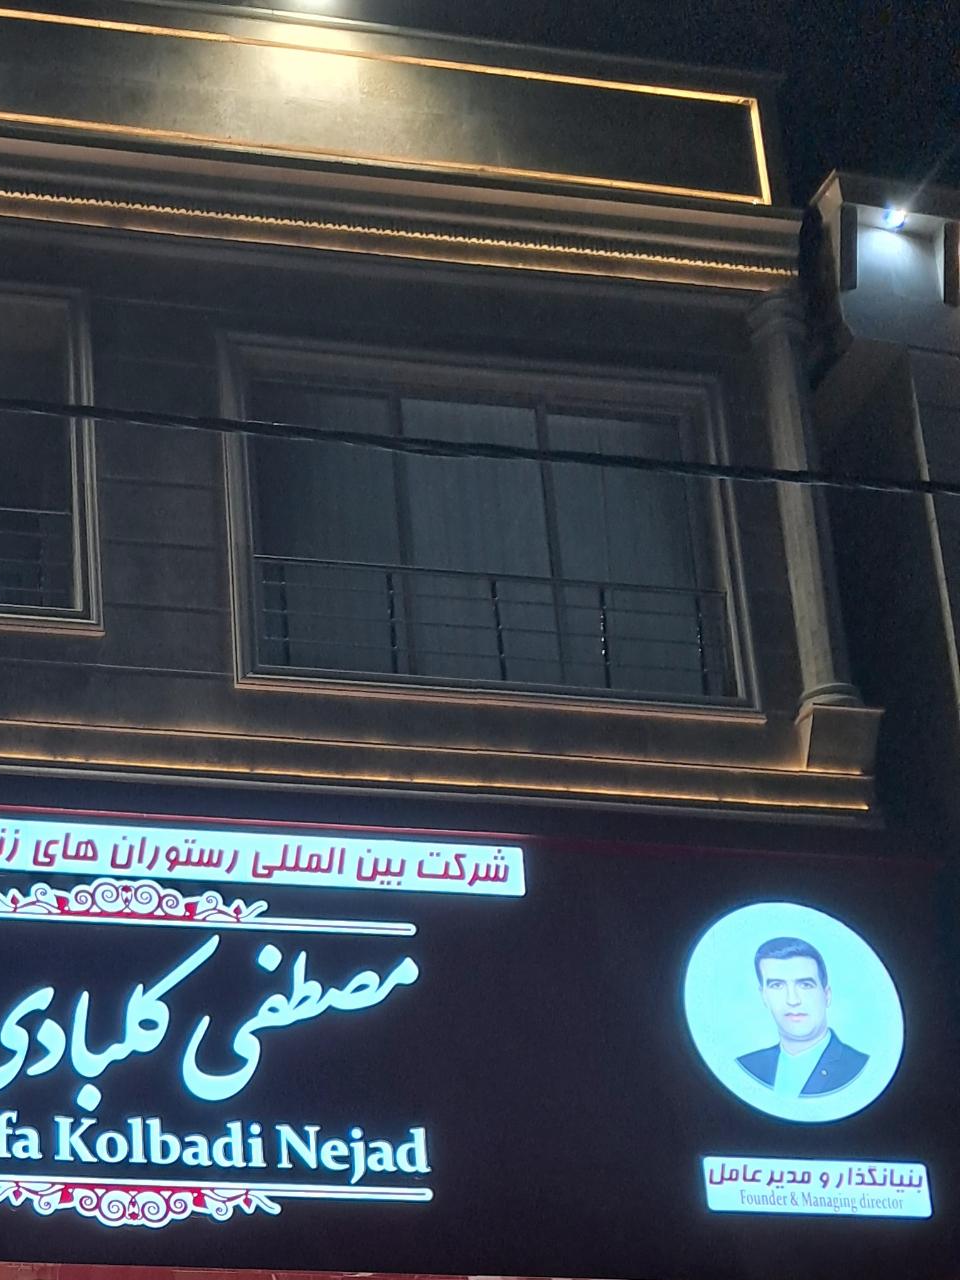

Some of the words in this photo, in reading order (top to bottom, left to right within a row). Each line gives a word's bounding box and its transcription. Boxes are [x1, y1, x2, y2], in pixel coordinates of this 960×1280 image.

[32, 831, 98, 868] های
[110, 836, 239, 875] رستوران
[251, 843, 347, 879] المللی
[356, 849, 407, 886] بین
[417, 847, 510, 887] شرکت
[180, 943, 421, 1102] مصطفی
[54, 1115, 267, 1169] Kolbadi
[276, 1123, 430, 1184] Nejad
[708, 1163, 763, 1186] عامل
[766, 1168, 812, 1191] مدیر
[819, 1172, 830, 1190] و
[836, 1165, 924, 1194] بنیانگذار
[740, 1189, 788, 1207] Founder
[790, 1193, 799, 1207] &
[801, 1192, 858, 1213] Managing
[859, 1194, 904, 1211] director
